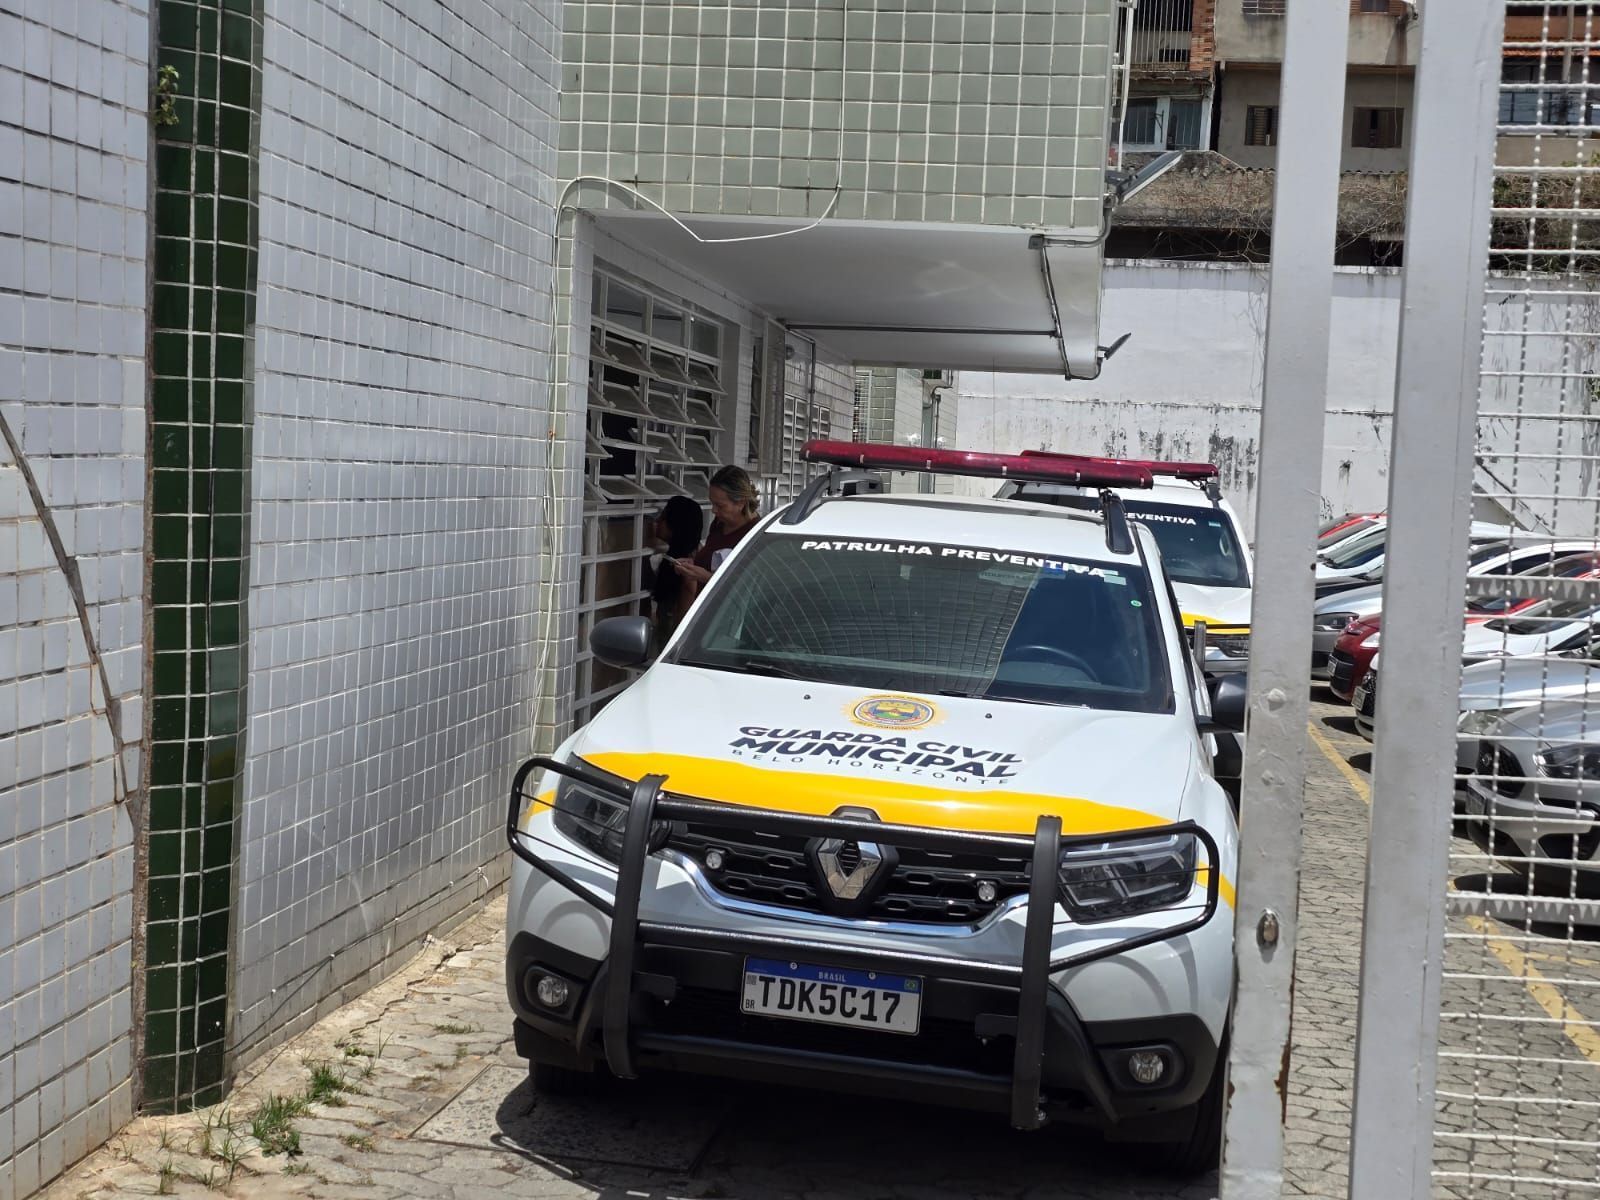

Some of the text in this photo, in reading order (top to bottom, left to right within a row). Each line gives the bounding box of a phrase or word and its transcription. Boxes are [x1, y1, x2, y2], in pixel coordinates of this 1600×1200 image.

[800, 541, 933, 556] PATRULHA
[941, 548, 1106, 578] PREVENTIVA
[728, 737, 1019, 778] MUNICIPAL
[738, 725, 907, 749] GUARDA
[916, 741, 1023, 763] CIVIL
[732, 749, 1009, 785] BELO HORIZONTE
[818, 971, 847, 983] BRASIL
[745, 998, 755, 1010] BR
[758, 975, 901, 1024] TDK5C17
